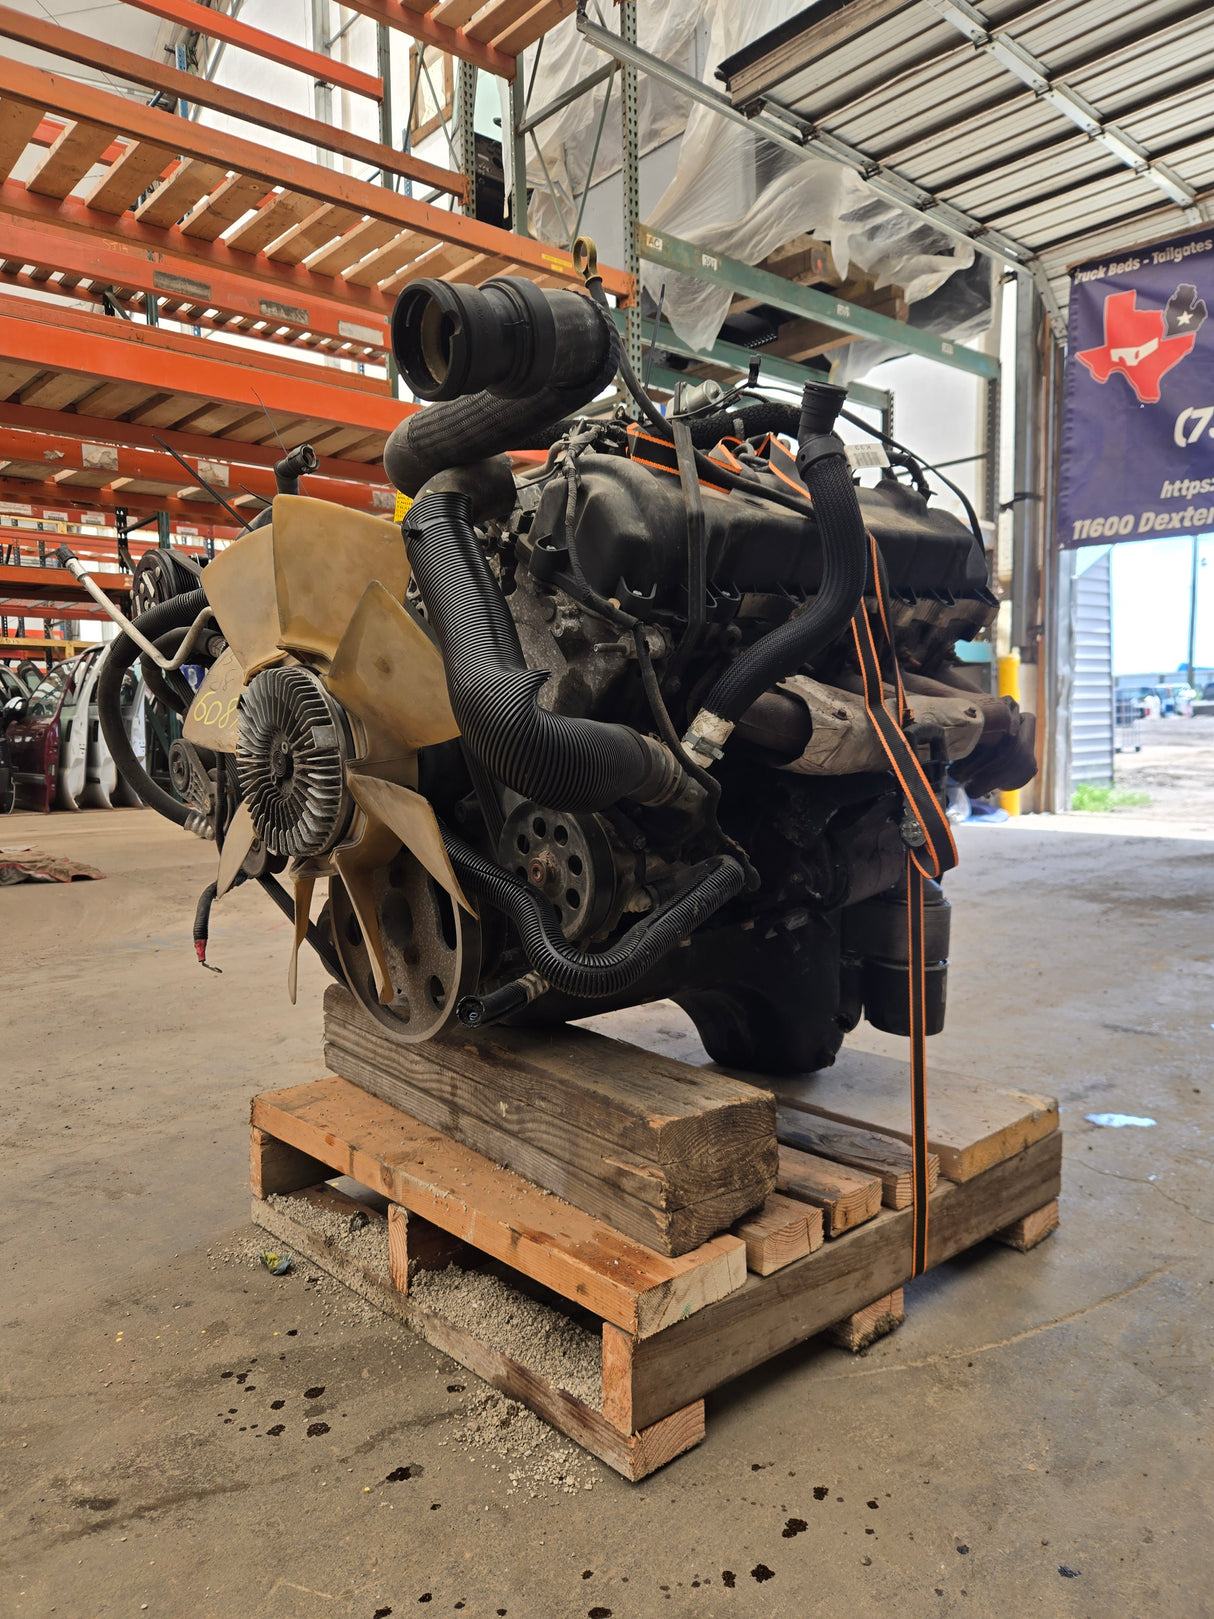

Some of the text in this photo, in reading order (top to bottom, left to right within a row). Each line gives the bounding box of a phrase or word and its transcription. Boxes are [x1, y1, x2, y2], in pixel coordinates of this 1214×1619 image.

[1107, 257, 1141, 277] Beds
[1152, 240, 1213, 266] Tailgates
[1174, 405, 1214, 448] (7
[1072, 514, 1135, 541] 11600
